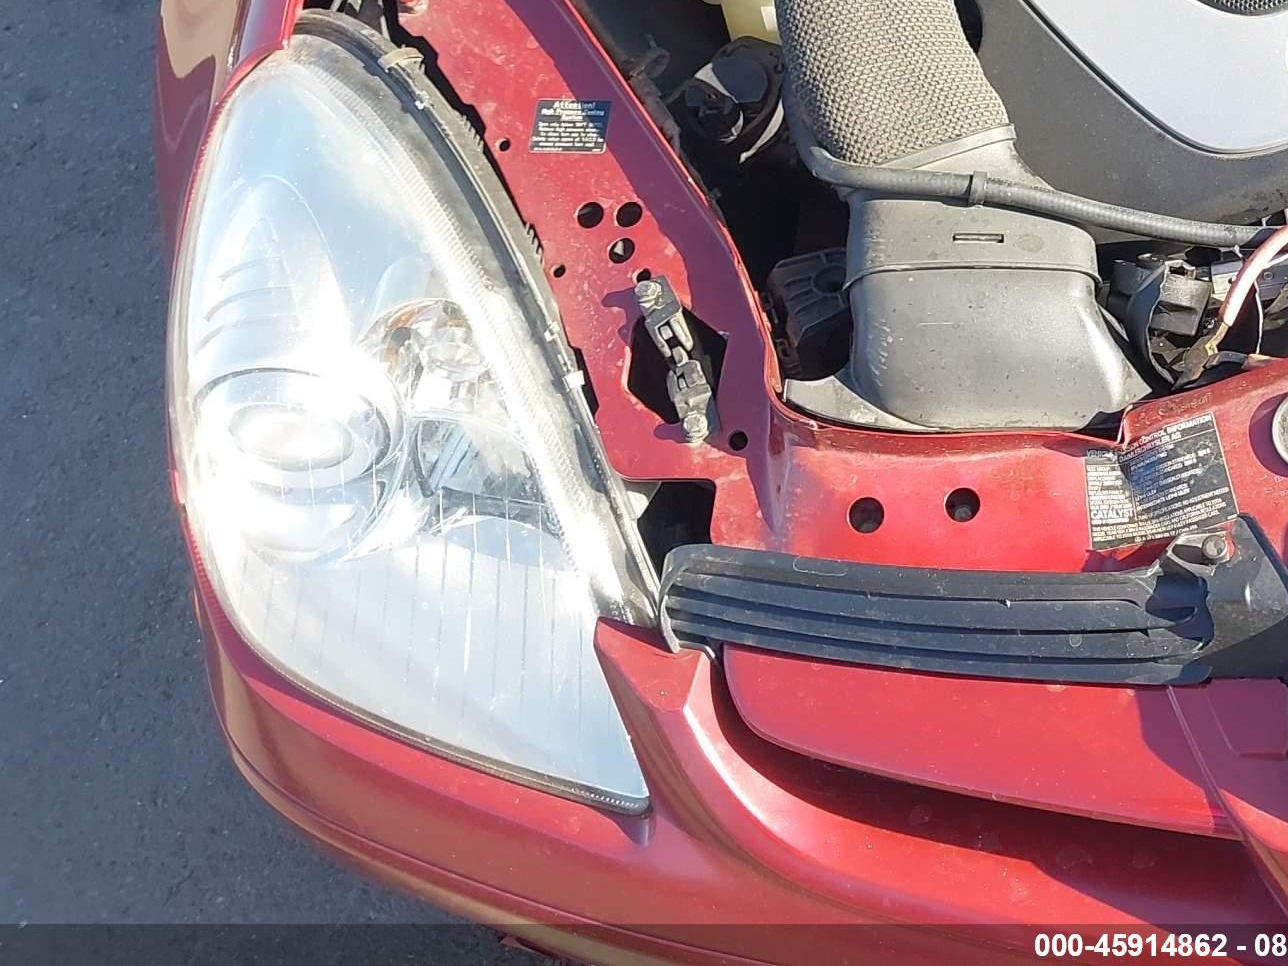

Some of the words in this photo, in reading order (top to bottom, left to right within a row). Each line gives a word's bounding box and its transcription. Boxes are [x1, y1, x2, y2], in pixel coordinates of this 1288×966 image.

[1139, 431, 1167, 445] CONTROL
[1166, 414, 1212, 435] INFORMATION
[1171, 432, 1182, 442] AG
[1091, 508, 1134, 519] CATALYST
